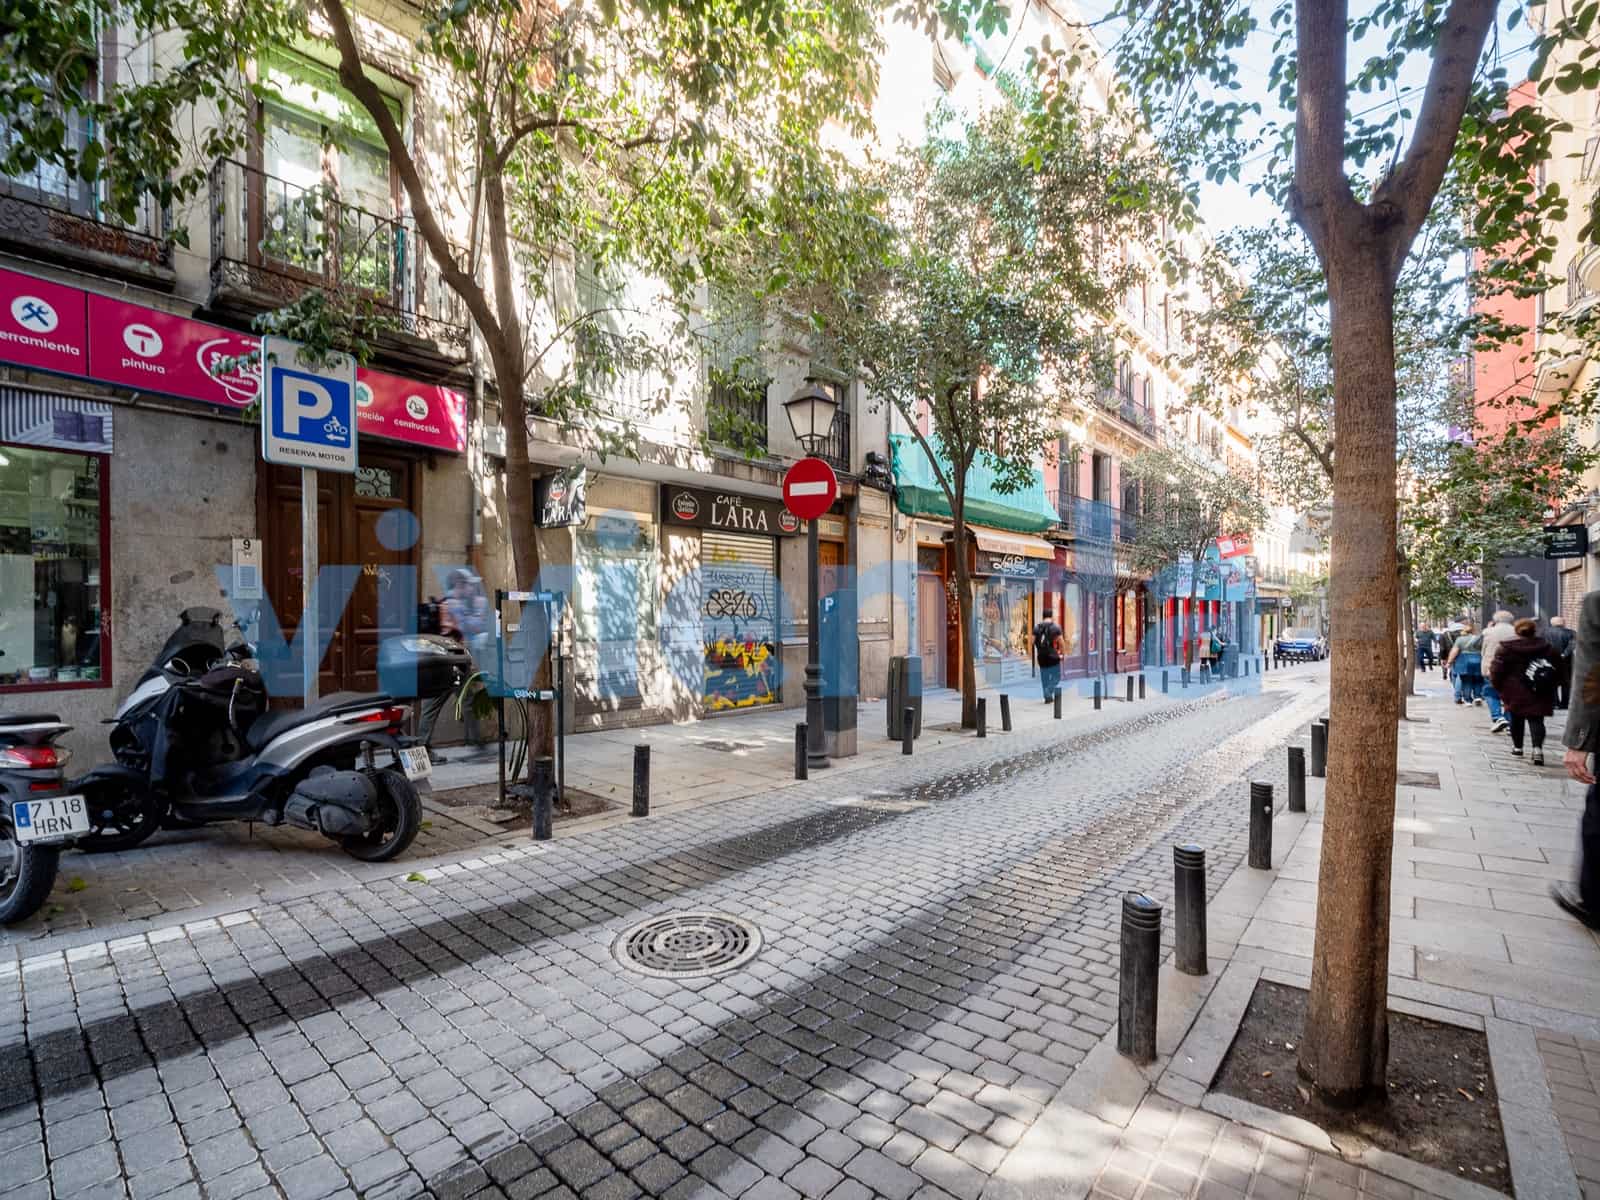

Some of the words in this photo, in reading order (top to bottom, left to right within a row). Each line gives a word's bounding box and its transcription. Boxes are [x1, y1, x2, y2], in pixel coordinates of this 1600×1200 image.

[121, 357, 166, 375] pintura
[282, 375, 333, 435] P
[393, 418, 441, 434] construcción
[279, 446, 317, 457] RESERVA
[318, 451, 346, 462] MOTOS
[716, 494, 742, 507] CAFÉ
[542, 505, 574, 524] LARA
[711, 502, 769, 531] LARA
[242, 539, 251, 550] 9
[824, 597, 834, 612] P
[31, 798, 82, 819] 7118
[33, 815, 73, 836] HRN
